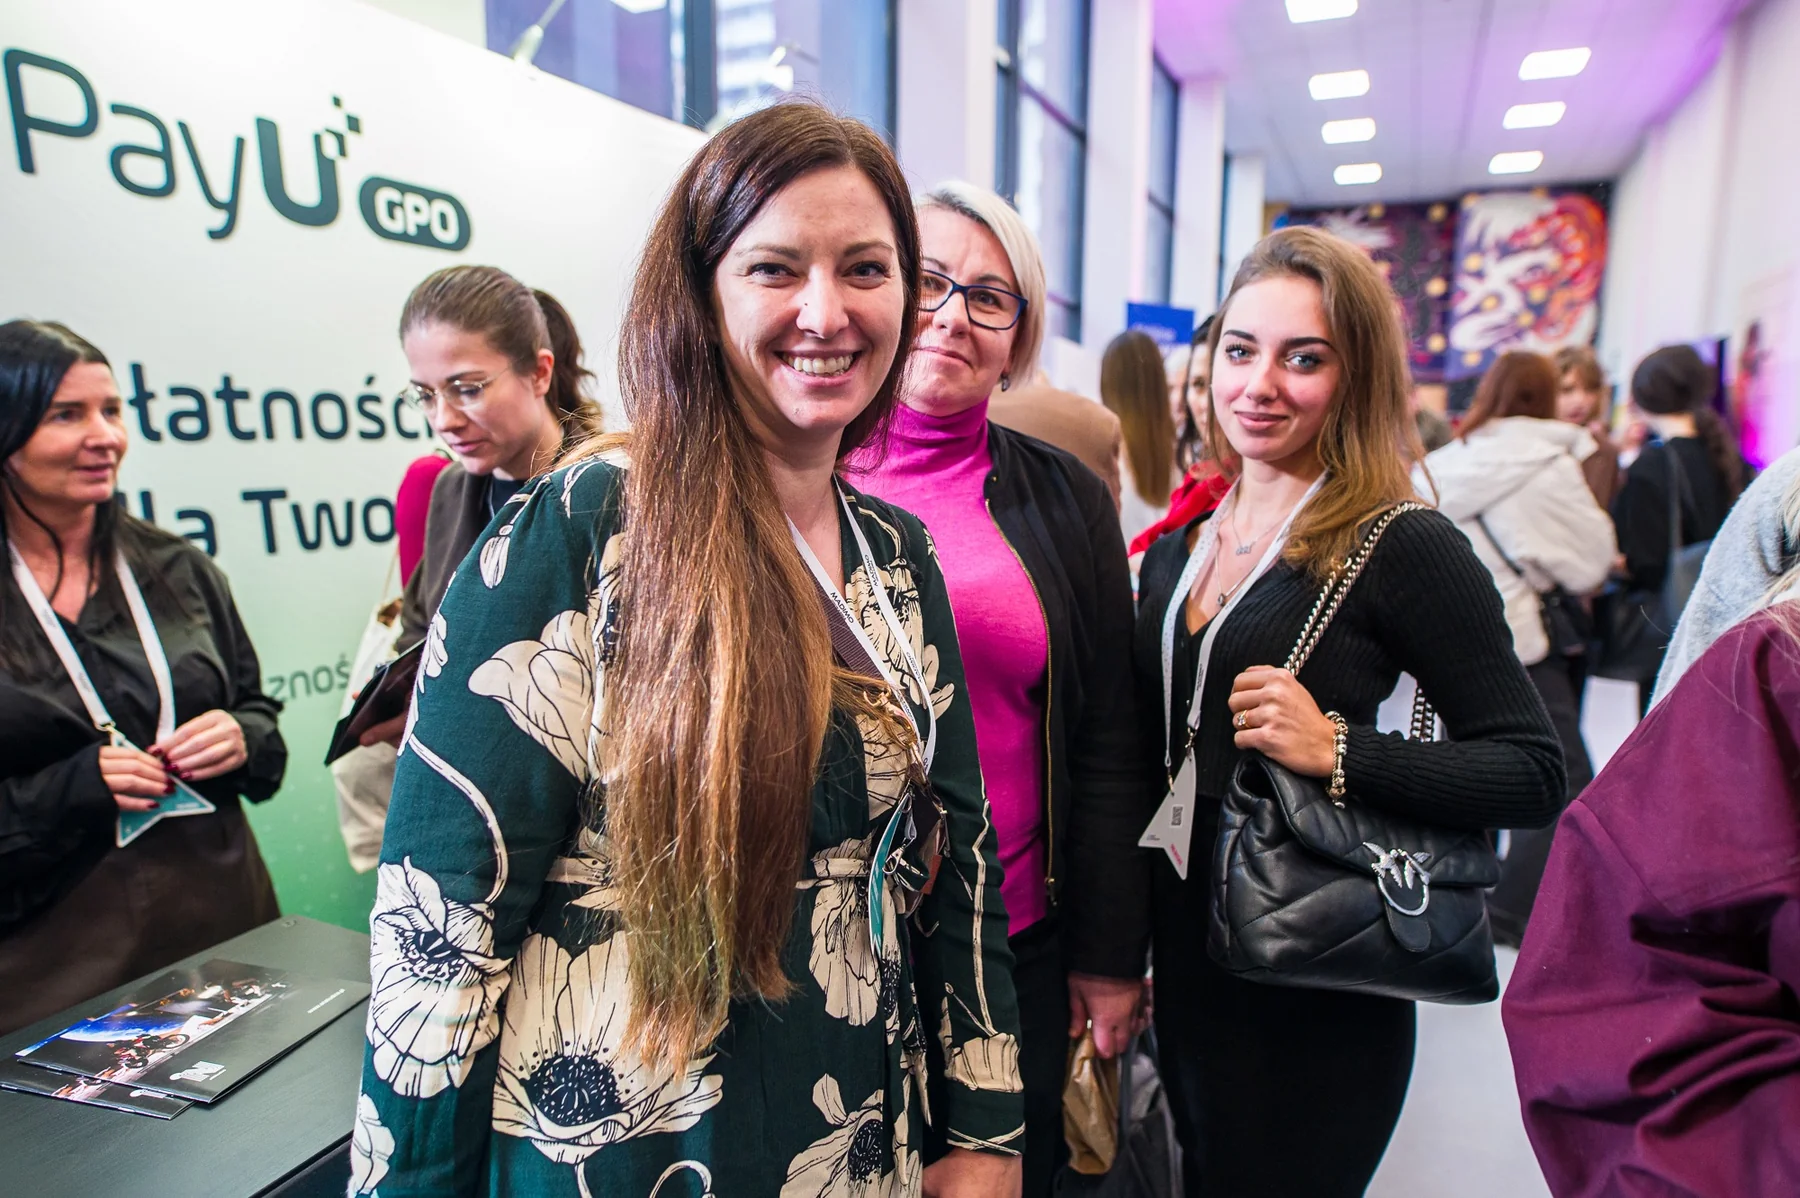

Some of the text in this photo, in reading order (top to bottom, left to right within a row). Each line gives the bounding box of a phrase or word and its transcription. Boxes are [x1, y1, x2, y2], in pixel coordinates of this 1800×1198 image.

[4, 48, 348, 240] PayU
[373, 186, 461, 244] GPO
[830, 592, 854, 624] MADIMO
